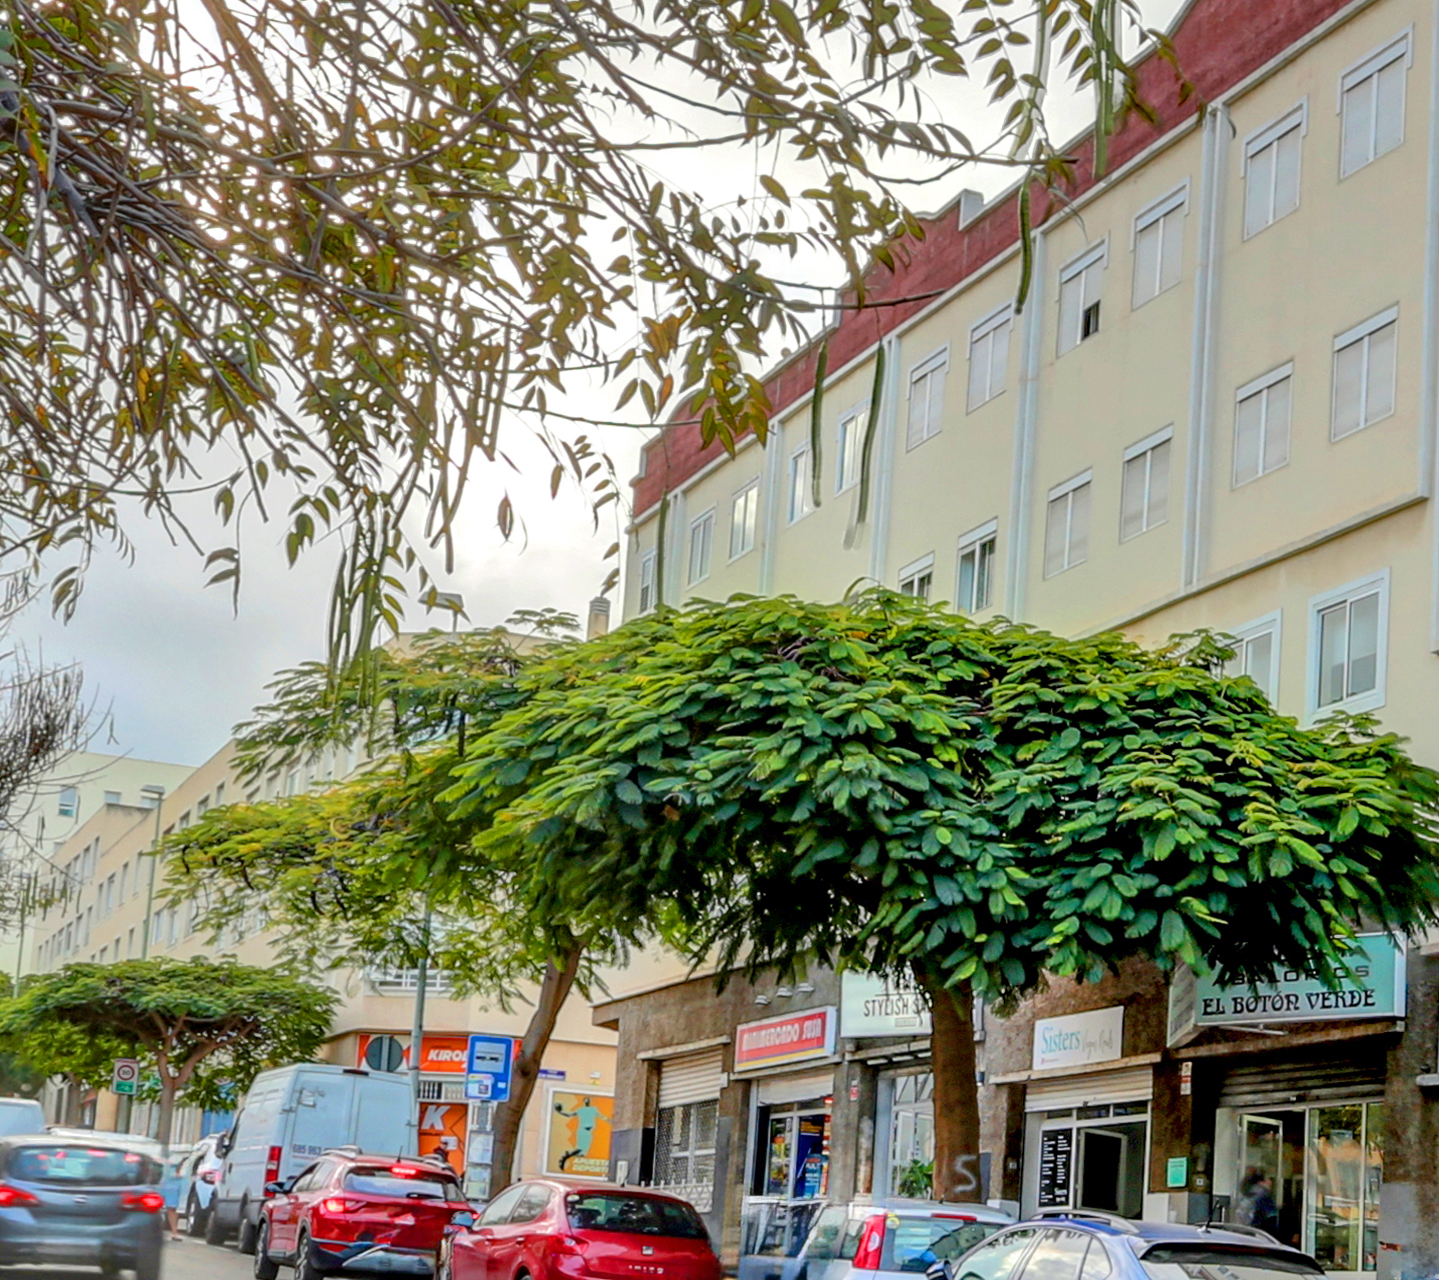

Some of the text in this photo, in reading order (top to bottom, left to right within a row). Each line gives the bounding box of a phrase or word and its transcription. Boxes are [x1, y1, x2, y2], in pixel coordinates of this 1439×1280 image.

[863, 997, 910, 1017] STYLISH
[1202, 988, 1376, 1016] EL BOTÓN VERDE
[1041, 1026, 1081, 1054] Sisters
[421, 1105, 451, 1131] K
